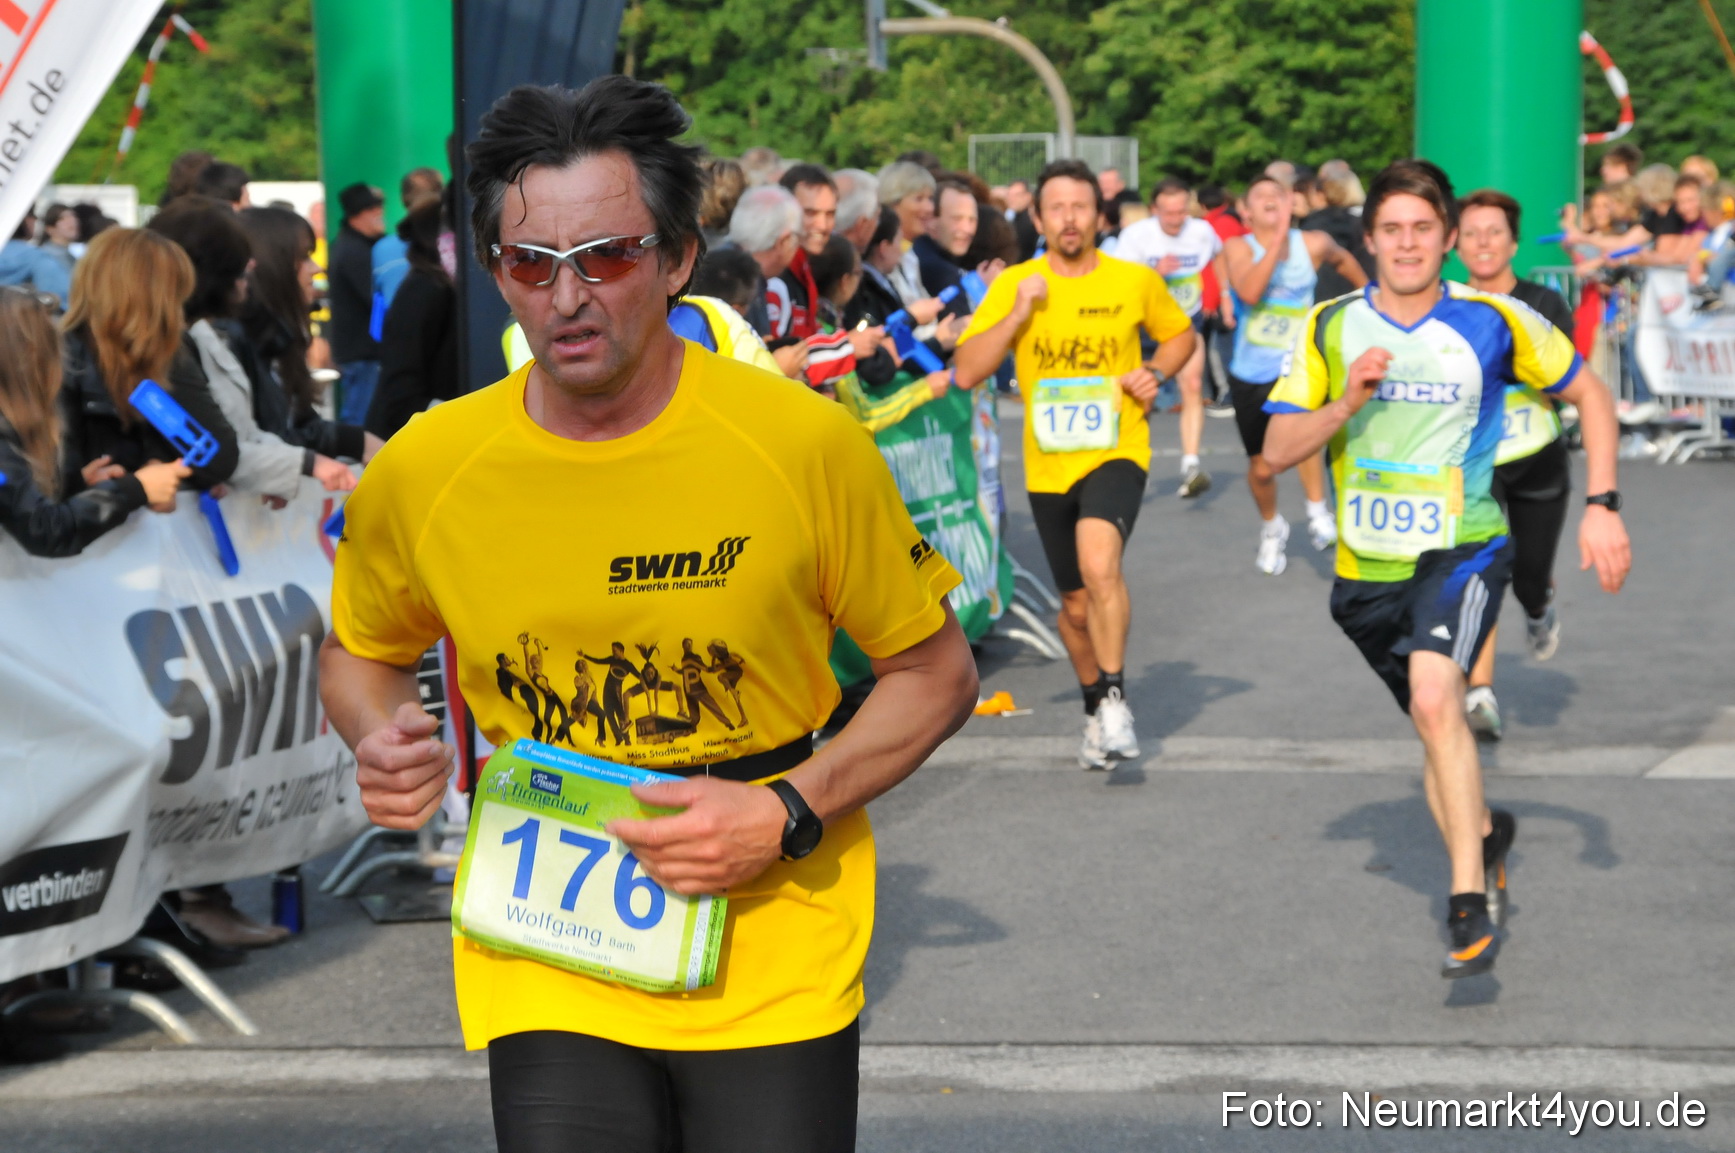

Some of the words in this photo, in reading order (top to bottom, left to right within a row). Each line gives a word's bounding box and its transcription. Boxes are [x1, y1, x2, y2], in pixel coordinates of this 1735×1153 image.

[1043, 403, 1103, 433] 179
[1348, 494, 1442, 535] 1093
[608, 551, 702, 582] swn
[608, 581, 669, 595] stadtwerke
[672, 577, 727, 590] neumarkt
[627, 751, 646, 760] Miss
[650, 746, 690, 758] Stadtbus
[690, 748, 729, 764] Parkhaus
[512, 782, 591, 816] firmenlauf
[2, 867, 106, 912] verbinden
[501, 817, 666, 931] 176
[506, 904, 602, 946] Wolfgang
[608, 936, 636, 953] Barth
[523, 933, 570, 952] Stadtwerke
[572, 944, 612, 963] Neumarkt
